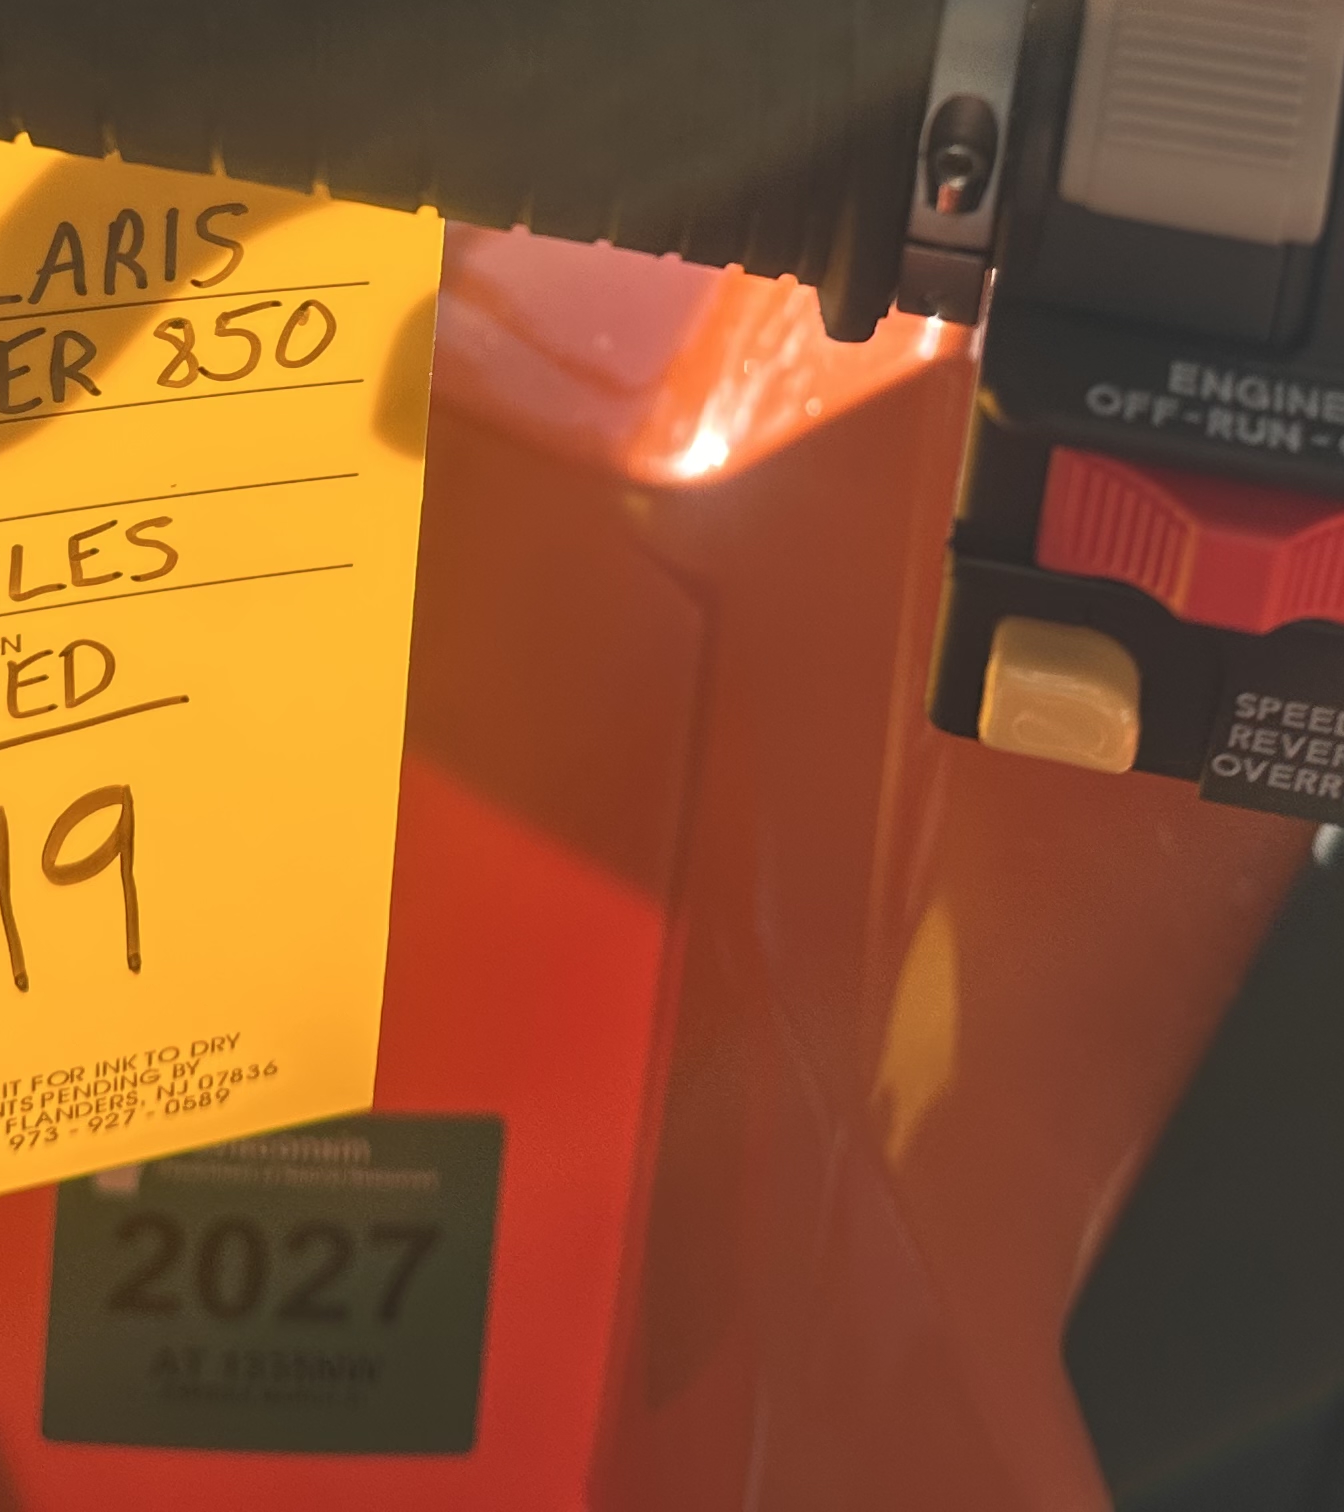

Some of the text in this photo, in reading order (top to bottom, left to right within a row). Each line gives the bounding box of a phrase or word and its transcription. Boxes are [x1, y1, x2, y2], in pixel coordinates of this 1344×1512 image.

[153, 298, 337, 388] 850
[30, 1066, 85, 1093] FOR
[95, 1053, 138, 1078] INK
[144, 1046, 180, 1067] TO
[190, 1032, 241, 1059] DRY
[40, 1068, 160, 1107] PENDING
[172, 1059, 200, 1080] BY
[156, 1076, 189, 1102] NJ
[198, 1059, 279, 1090] 07836
[9, 1127, 58, 1151] 973
[87, 1109, 136, 1134] 927
[163, 1088, 231, 1116] 0589
[108, 1209, 443, 1326] 2027
